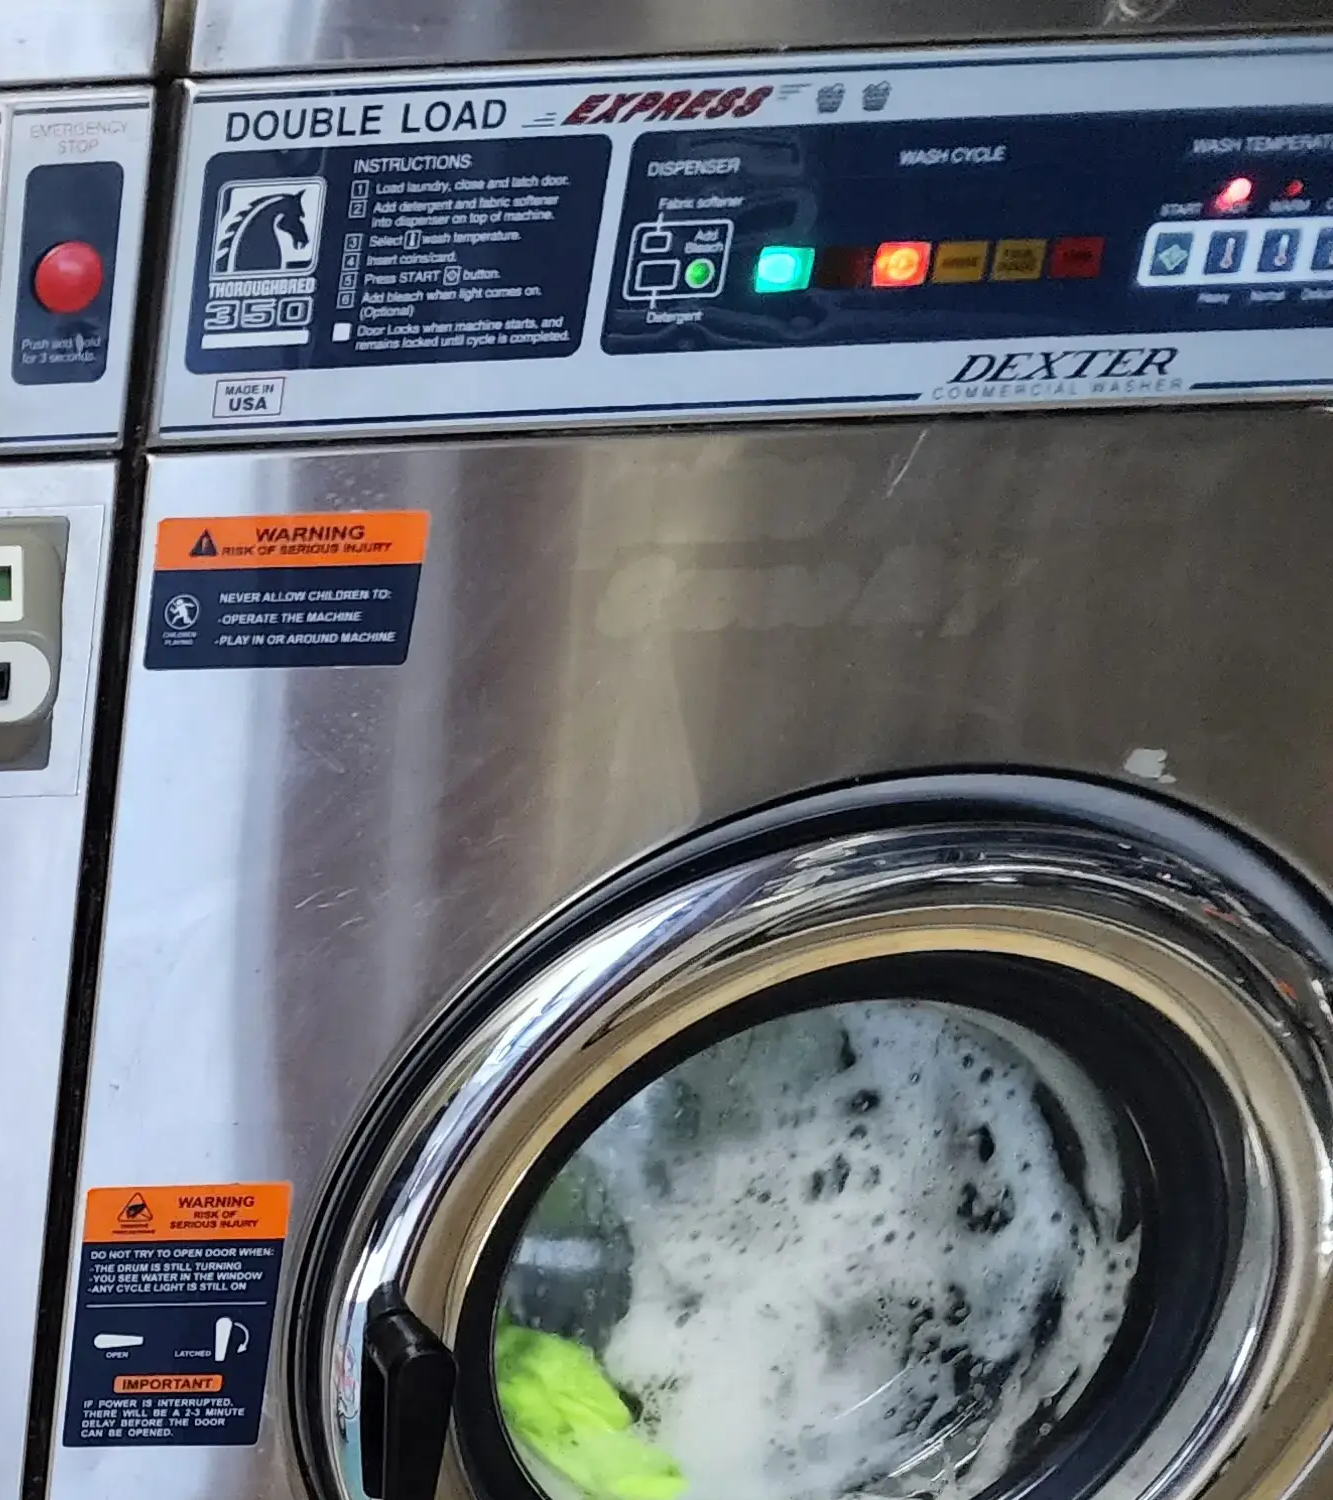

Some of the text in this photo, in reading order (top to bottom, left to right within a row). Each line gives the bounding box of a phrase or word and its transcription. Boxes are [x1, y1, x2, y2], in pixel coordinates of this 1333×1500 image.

[561, 85, 773, 125] EXPRESS
[30, 122, 128, 138] EMERGENCY
[226, 99, 507, 142] DOUBLE LOAD
[58, 140, 99, 153] STOP
[899, 145, 1006, 165] WASH CYCLE
[354, 154, 473, 173] INSTRUCTIONS
[647, 157, 740, 177] DISPENSER
[208, 278, 317, 299] THOROUGHBRED
[204, 299, 313, 330] 350
[948, 347, 1178, 383] DEXTER
[933, 378, 1184, 401] COMMERCIAL WASHER
[229, 397, 267, 412] USA
[256, 525, 365, 542] WARNING
[219, 592, 260, 604] NEVER
[263, 591, 305, 602] ALLOW
[308, 590, 369, 601] CHILDREN
[178, 1196, 254, 1208] WARNING
[91, 1251, 107, 1259] DO
[109, 1250, 131, 1259] NOT
[134, 1250, 154, 1258] TRY
[157, 1249, 171, 1258] TO
[174, 1249, 202, 1258] OPEN
[205, 1248, 236, 1257] DOOR
[122, 1378, 213, 1390] IMPORTANT
